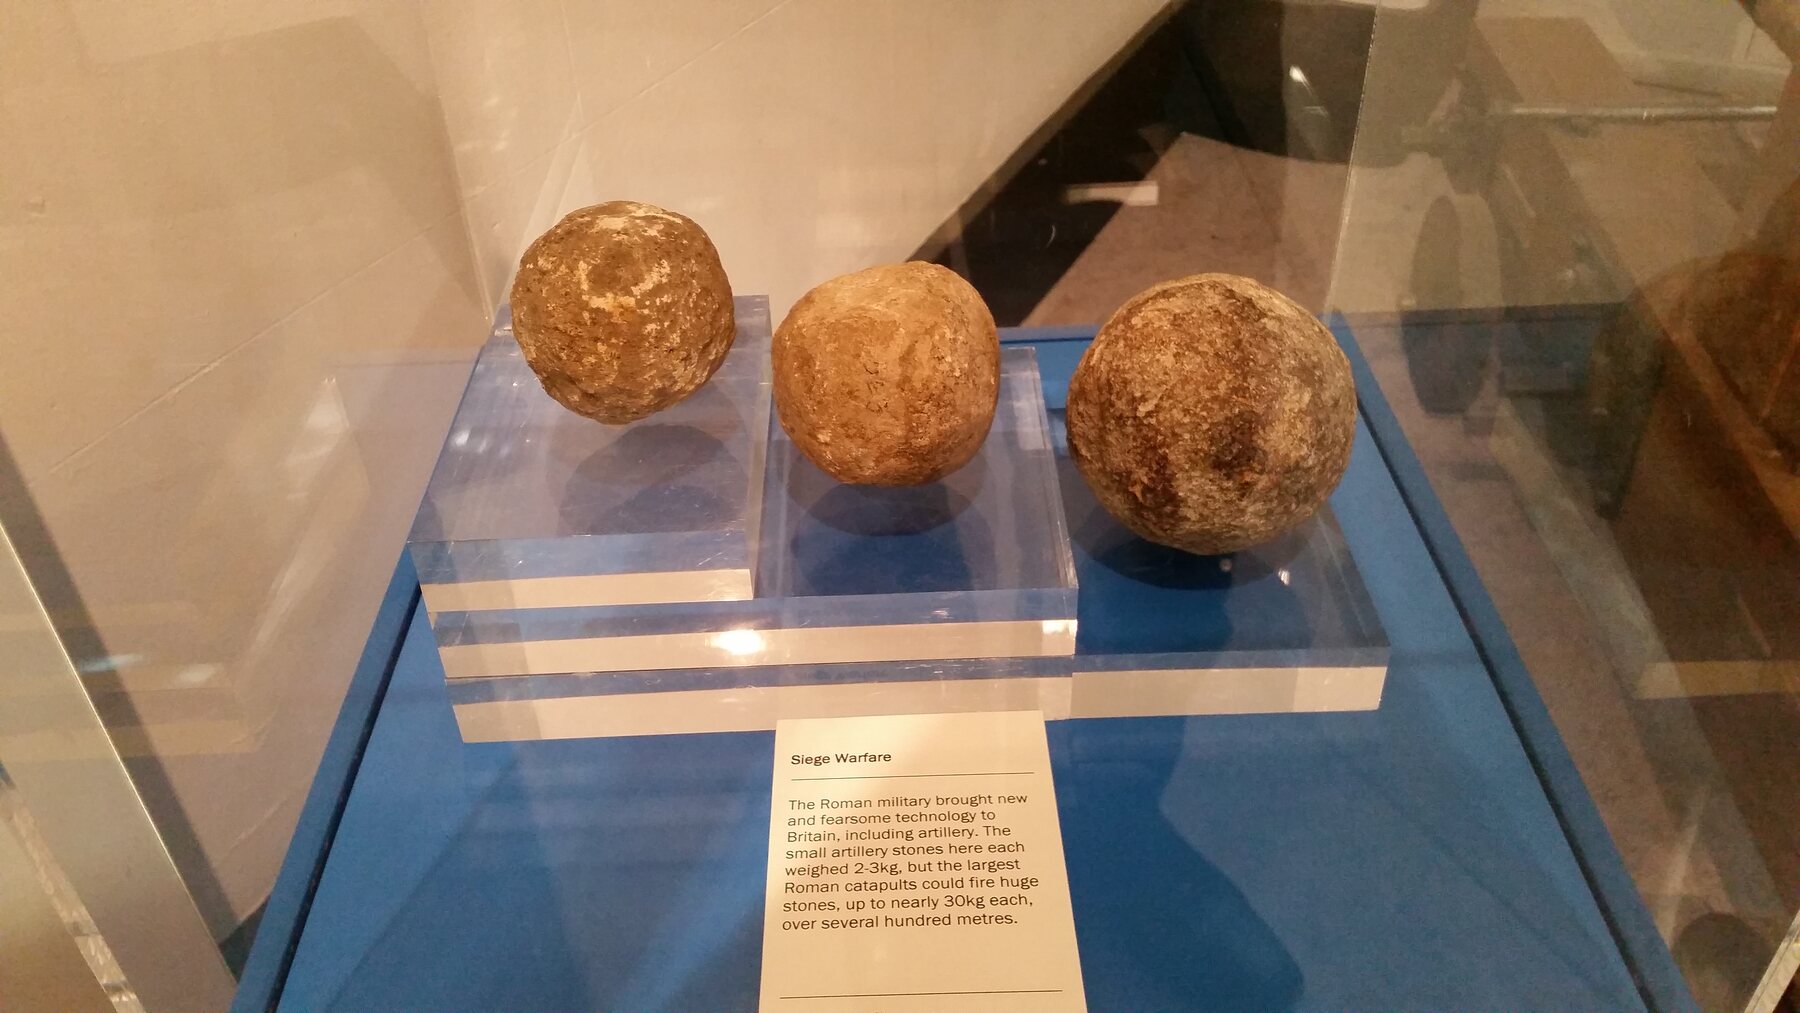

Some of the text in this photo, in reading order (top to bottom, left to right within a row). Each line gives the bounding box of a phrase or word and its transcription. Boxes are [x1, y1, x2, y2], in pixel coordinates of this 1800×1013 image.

[791, 752, 892, 767] Siege Warfare
[788, 794, 1028, 811] The Roman military brought new
[787, 810, 996, 827] and fearsome technology to
[787, 825, 1011, 843] Britain, including artillery. The
[785, 841, 1025, 860] small artillery stones here each
[785, 859, 1021, 879] weighed 2-3kg, but the largest
[785, 876, 1039, 894] Roman catapults could fire huge
[783, 893, 1033, 913] stones, up to nearly 30kg each,
[782, 913, 1018, 931] over several hundred metres.
